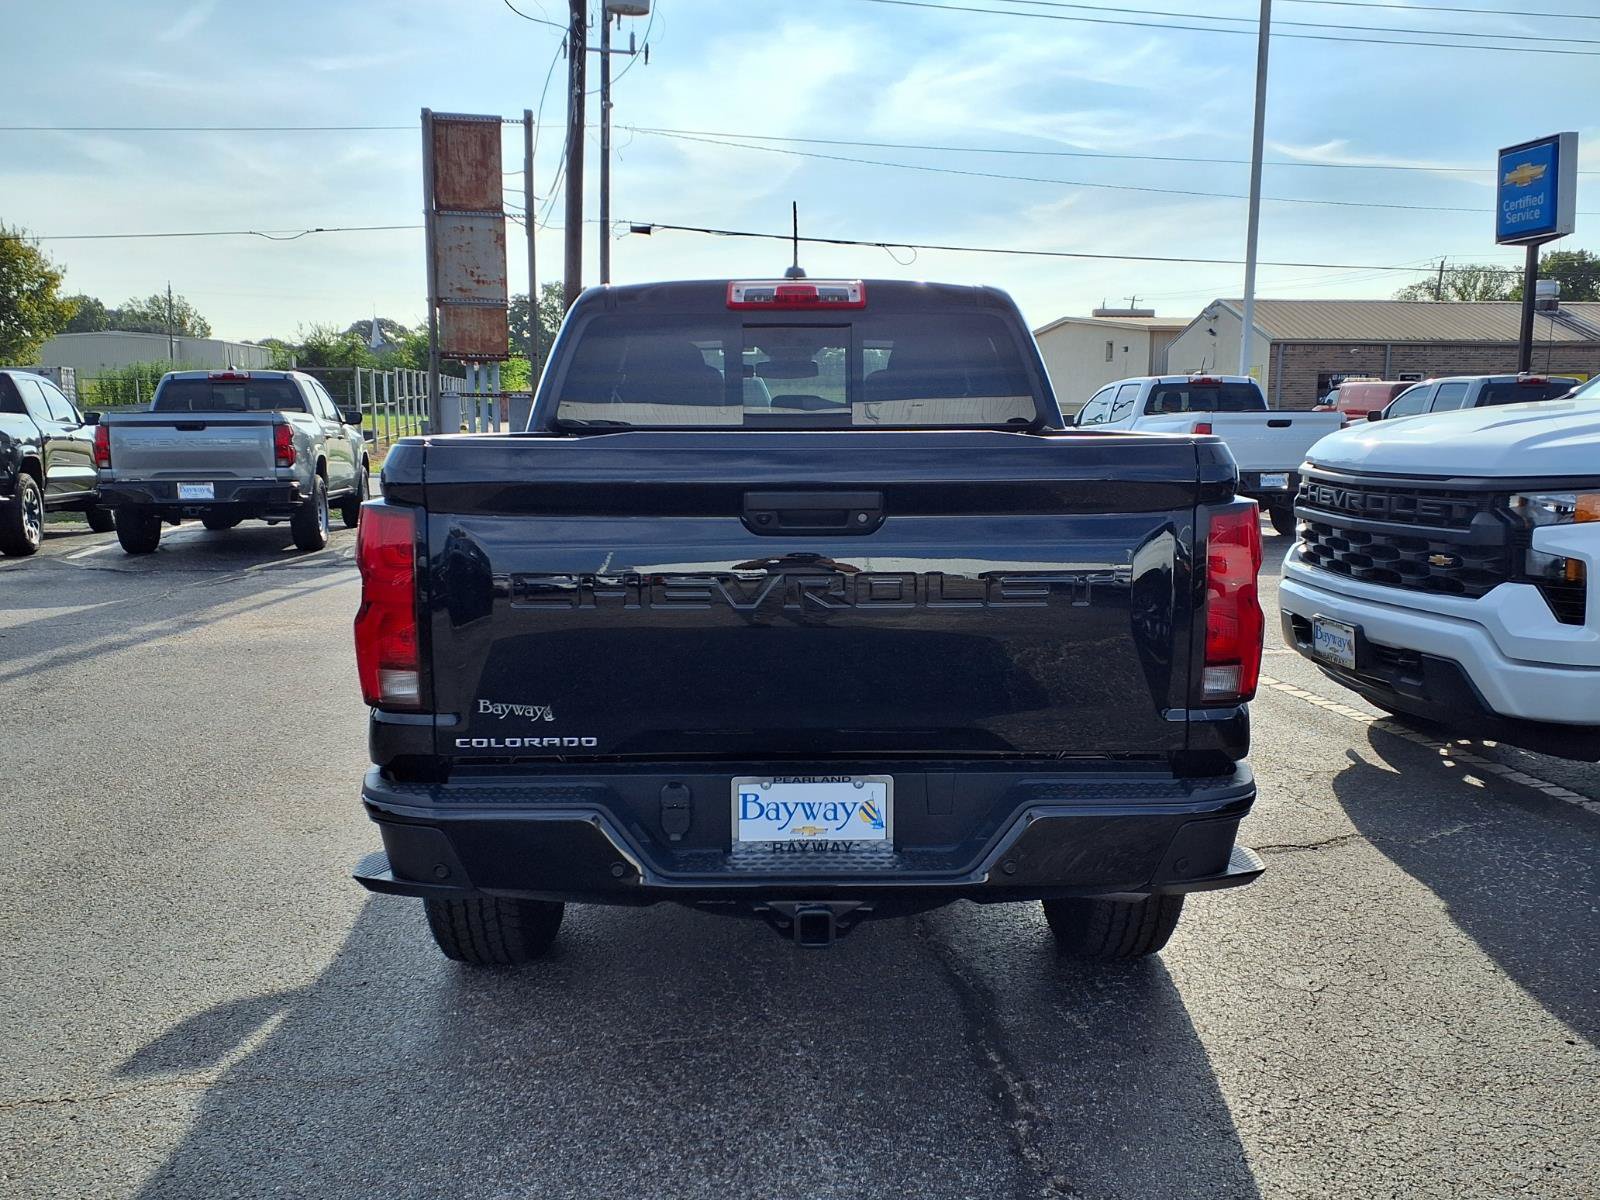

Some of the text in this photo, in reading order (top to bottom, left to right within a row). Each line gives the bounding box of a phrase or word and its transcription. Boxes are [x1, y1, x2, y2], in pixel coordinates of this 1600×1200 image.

[1503, 192, 1544, 212] Certified
[1505, 208, 1541, 225] Service
[1299, 484, 1474, 518] CHEVROLET
[509, 571, 1117, 609] CHEVROLET
[1314, 625, 1348, 652] Bayway
[478, 699, 543, 721] Bayway
[455, 737, 598, 748] COLORADO
[773, 775, 852, 784] PEARLAND
[739, 793, 859, 831] Bayway
[772, 841, 854, 853] BAYWAY
